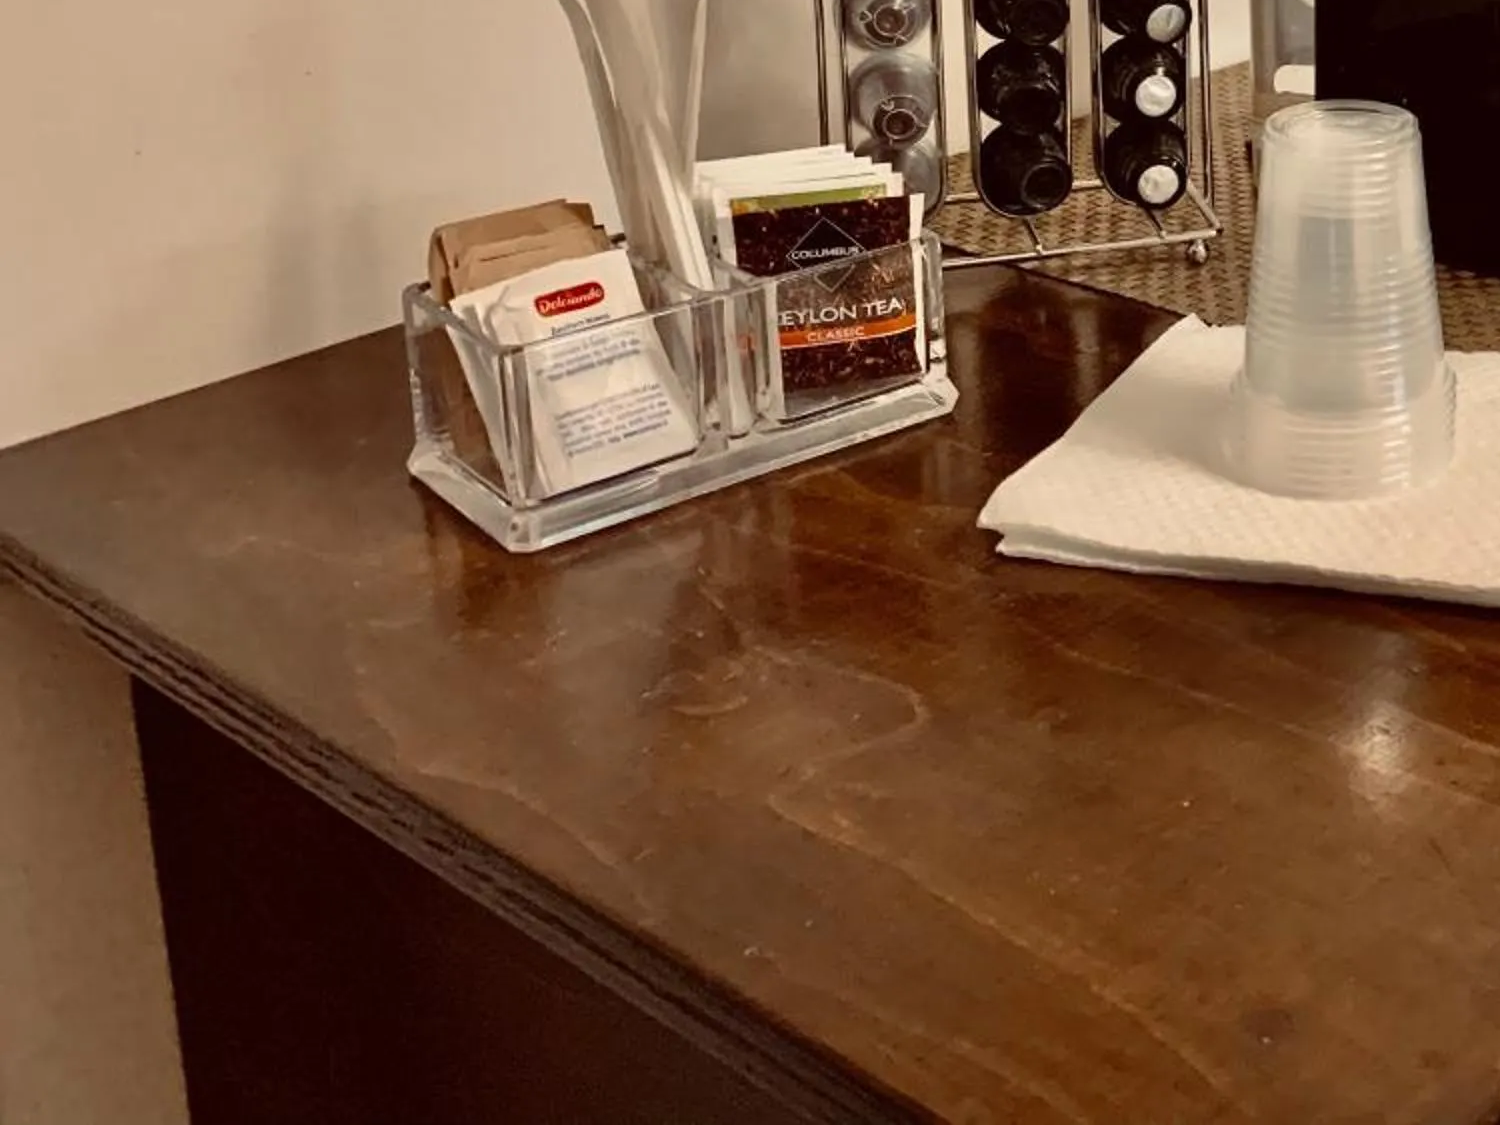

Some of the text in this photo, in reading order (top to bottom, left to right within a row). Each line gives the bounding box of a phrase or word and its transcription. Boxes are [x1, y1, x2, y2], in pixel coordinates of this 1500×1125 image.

[791, 246, 860, 260] COLUMBUS
[777, 297, 903, 326] EYLON TEA
[806, 326, 866, 342] CLASSIC
